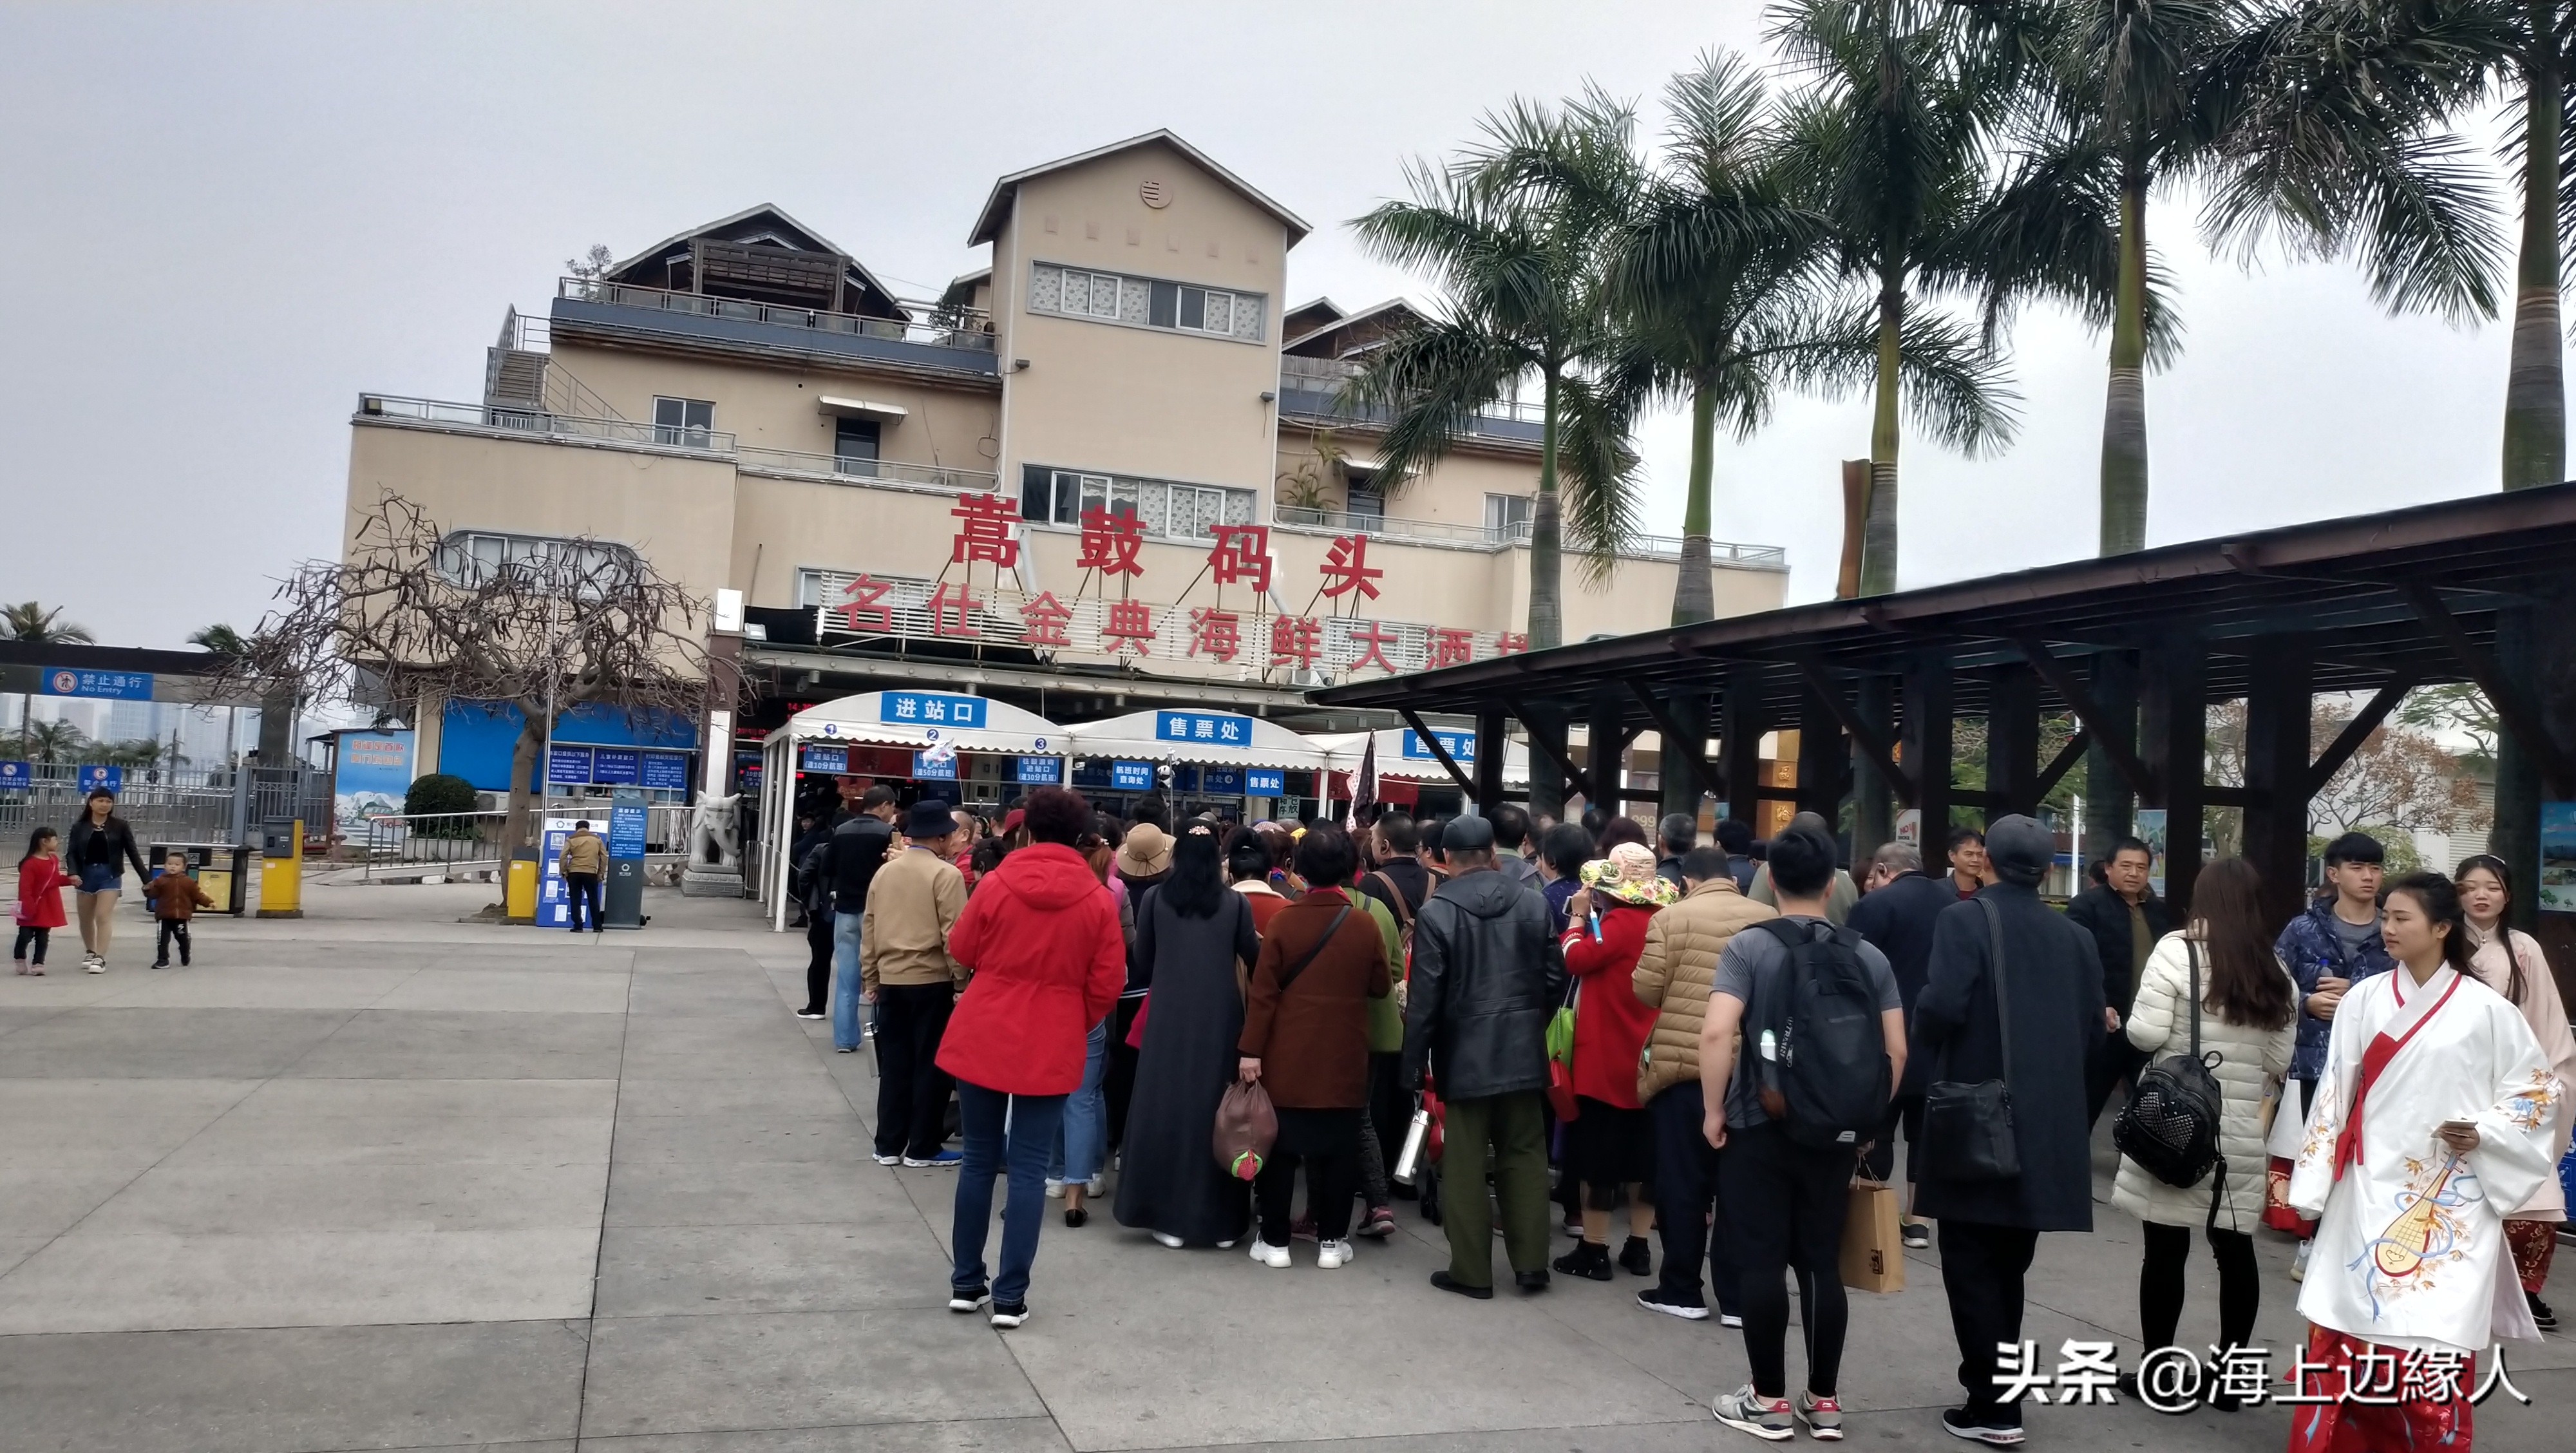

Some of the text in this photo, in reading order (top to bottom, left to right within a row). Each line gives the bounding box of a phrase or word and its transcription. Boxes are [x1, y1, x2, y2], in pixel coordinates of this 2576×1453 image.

[951, 493, 1384, 602] 嵩鼓码头
[82, 673, 143, 689] 禁止通行
[97, 686, 122, 695] Entry
[896, 698, 974, 722] 进站口
[1169, 717, 1240, 741] 售票处
[1116, 766, 1149, 775] 航班时间
[1119, 775, 1144, 784] 查询处
[1250, 777, 1280, 789] 售票处
